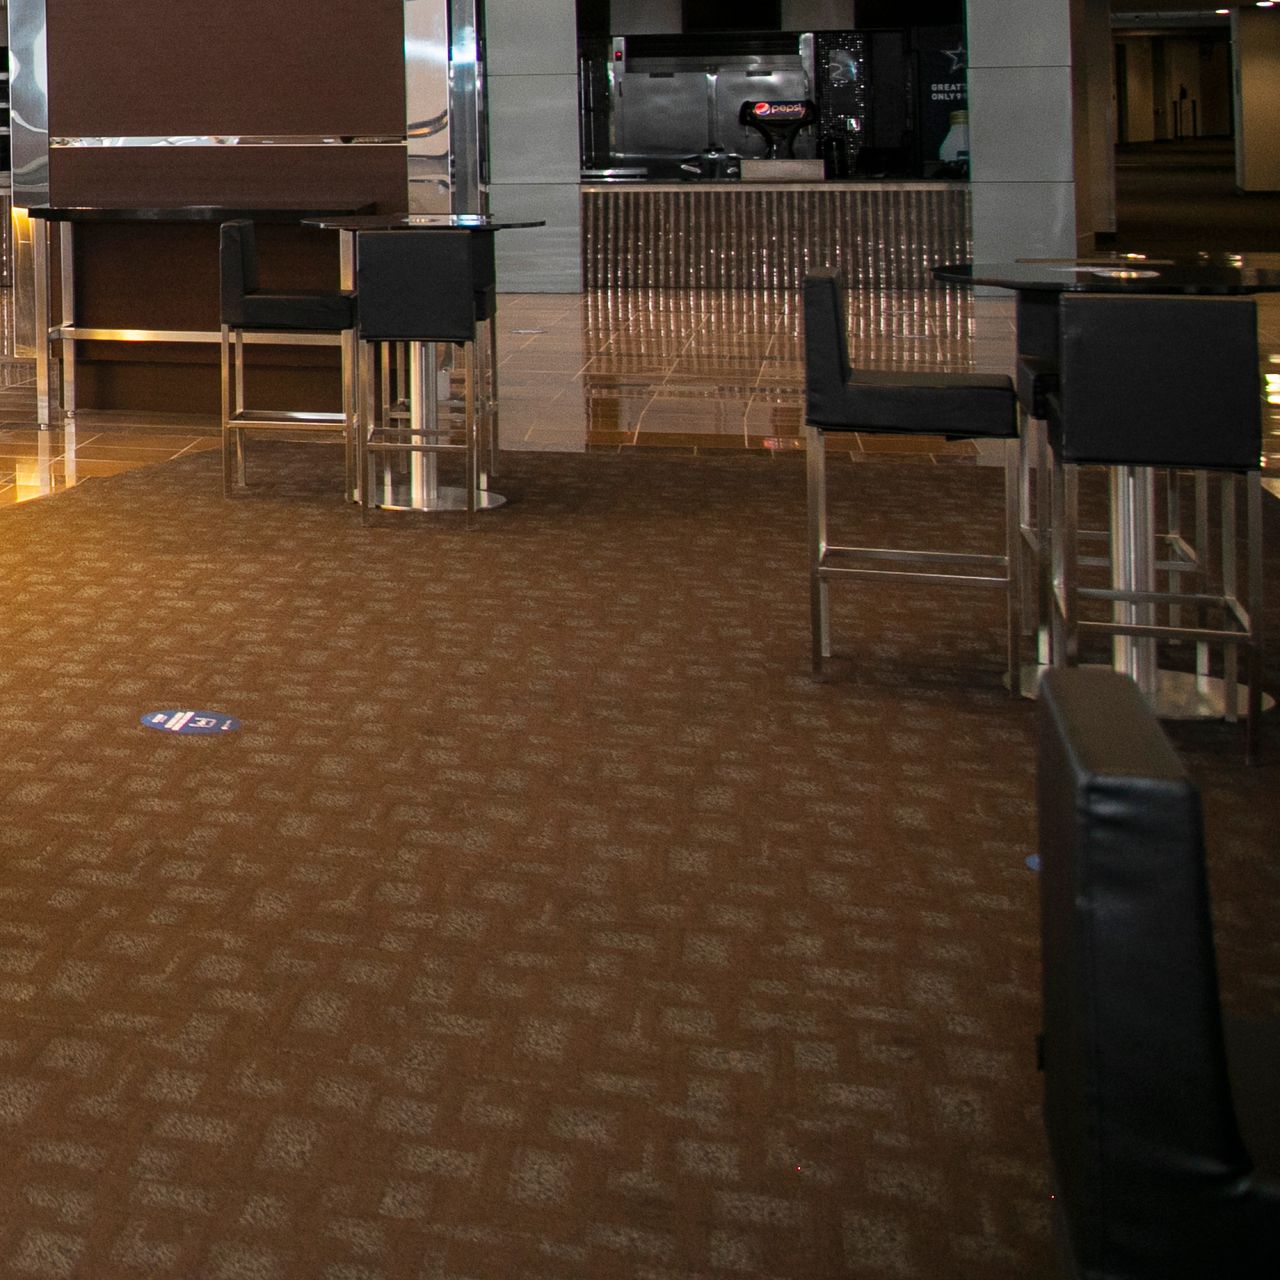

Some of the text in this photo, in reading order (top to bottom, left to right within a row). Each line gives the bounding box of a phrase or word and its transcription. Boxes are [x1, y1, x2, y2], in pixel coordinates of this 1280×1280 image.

[930, 83, 962, 91] GREAT
[930, 93, 955, 101] ONLY
[771, 102, 802, 114] pepsi
